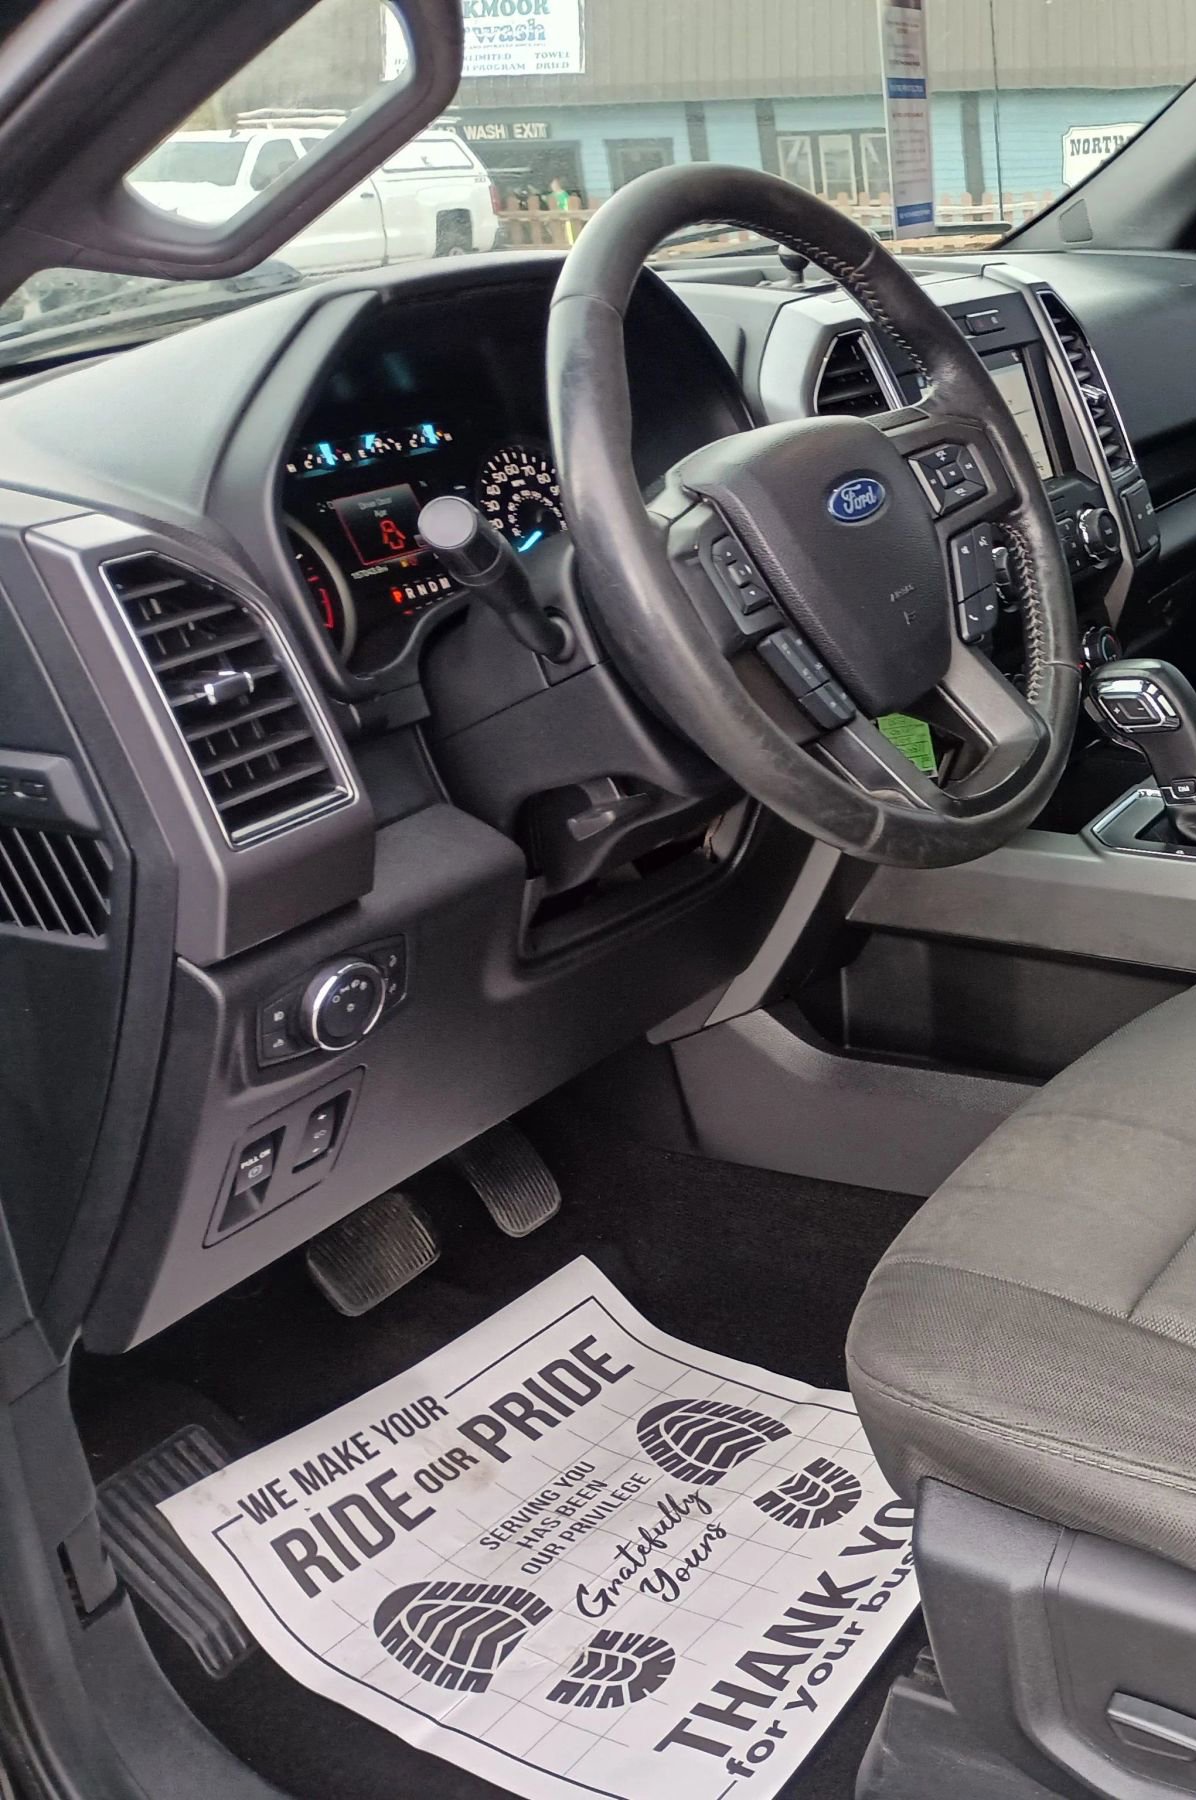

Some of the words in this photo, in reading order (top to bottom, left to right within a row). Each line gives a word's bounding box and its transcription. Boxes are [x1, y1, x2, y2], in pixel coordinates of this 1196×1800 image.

[534, 51, 570, 60] TOWEL
[463, 123, 506, 141] WASH
[513, 122, 547, 139] EXIT
[1070, 135, 1134, 156] NORTH
[491, 471, 508, 484] 50
[504, 464, 520, 476] 60
[520, 465, 536, 476] 70
[536, 472, 552, 484] 80
[484, 500, 500, 512] 30
[840, 484, 877, 514] Ford
[404, 587, 416, 599] R
[416, 584, 428, 596] N
[428, 580, 438, 593] D
[237, 1478, 298, 1525] WE
[289, 1431, 381, 1496] MAKE
[370, 1395, 450, 1445] YOUR
[270, 1467, 437, 1599] RIDE
[413, 1447, 480, 1494] OUR
[456, 1334, 636, 1464] PRIDE
[480, 1489, 561, 1550] SERVING
[554, 1460, 596, 1489] YOU
[516, 1516, 562, 1549] HAS
[555, 1479, 608, 1518] BEEN
[521, 1542, 566, 1575] OUR
[558, 1472, 652, 1543] PRIVILEGE
[576, 1488, 713, 1618] Gratefully
[640, 1521, 727, 1602] Yours
[653, 1570, 878, 1758] THANK
[726, 1720, 788, 1778] for
[782, 1621, 864, 1712] your
[856, 1540, 914, 1613] bus
